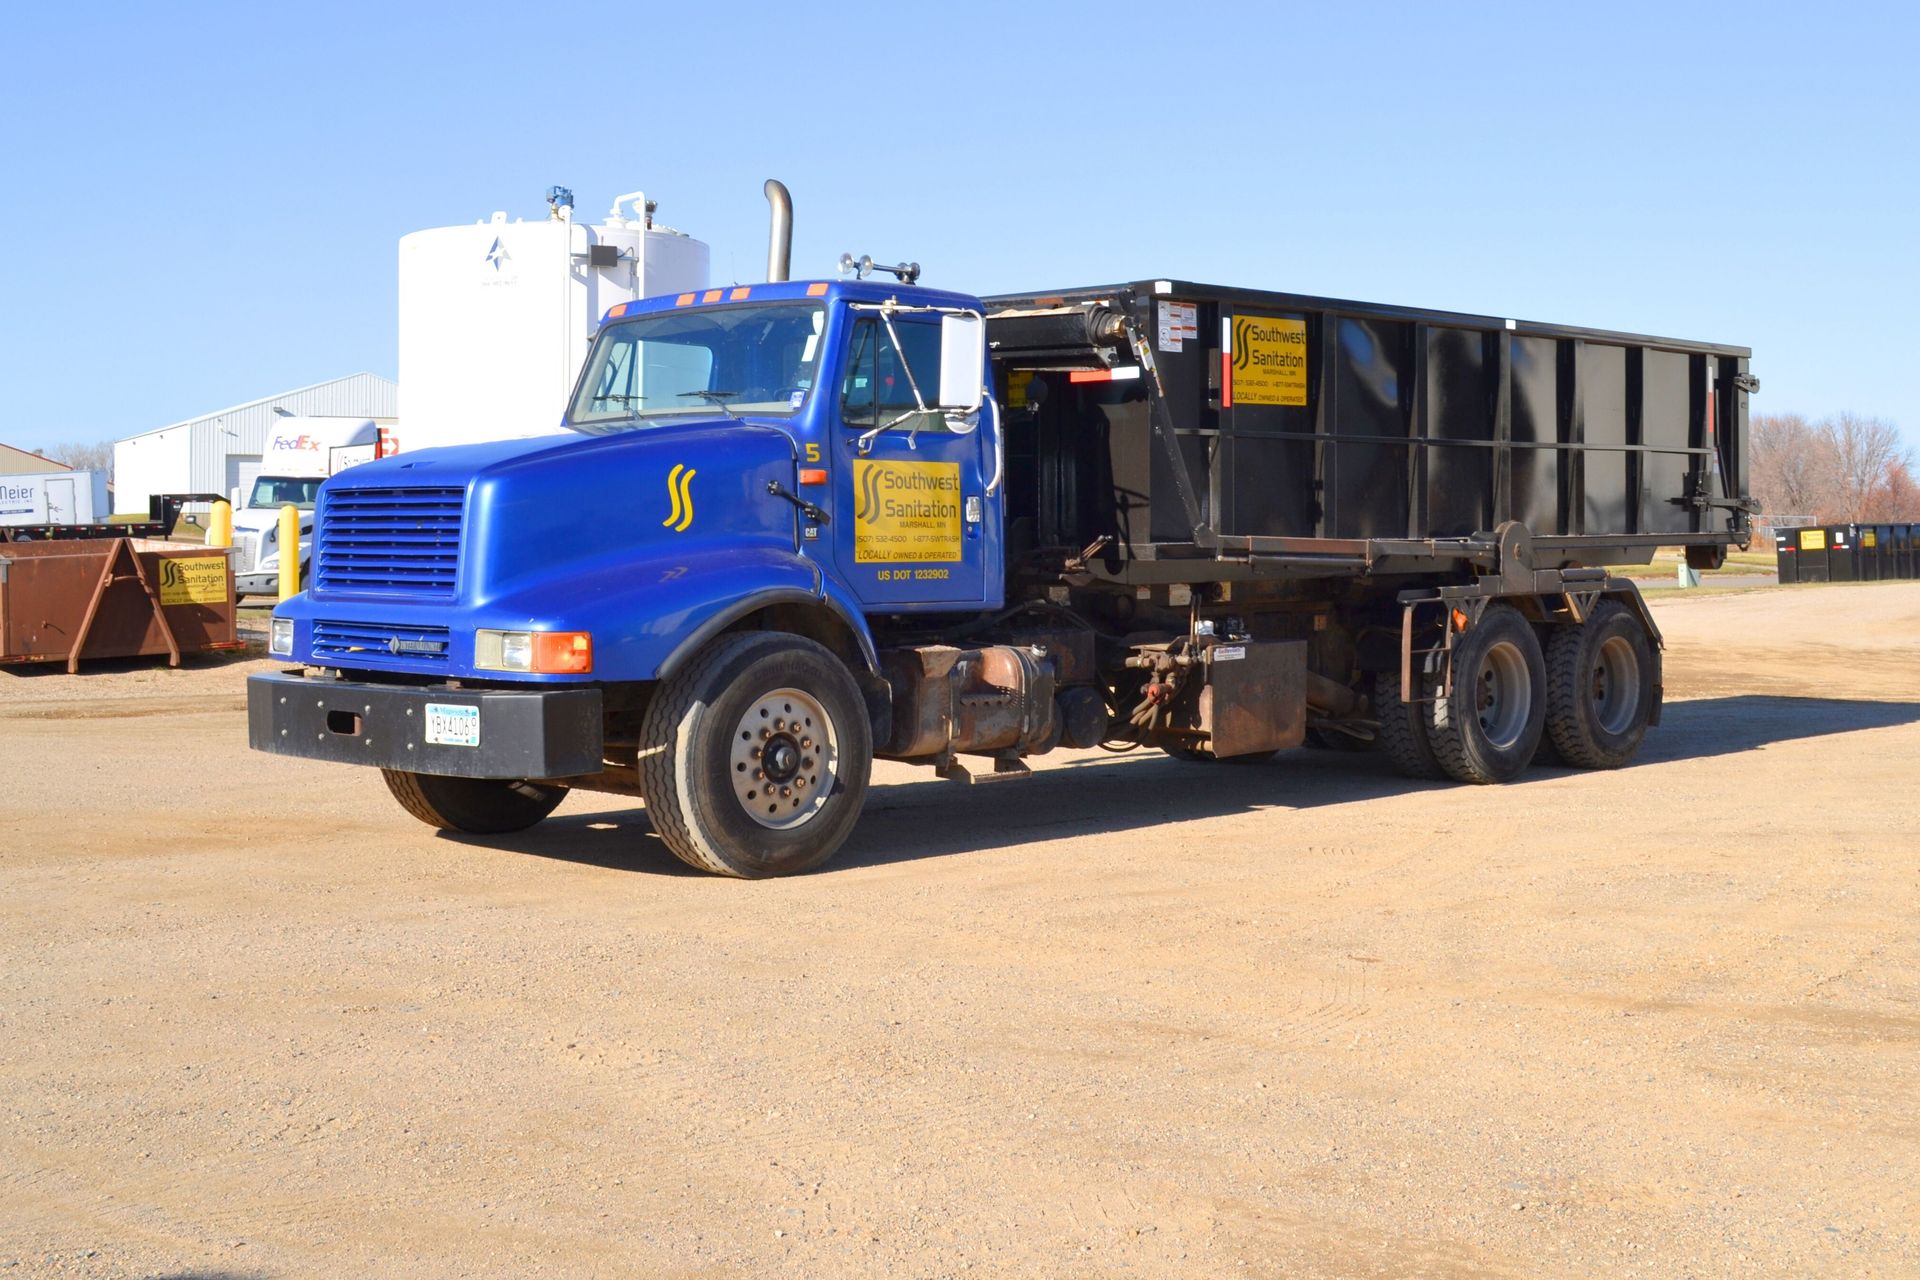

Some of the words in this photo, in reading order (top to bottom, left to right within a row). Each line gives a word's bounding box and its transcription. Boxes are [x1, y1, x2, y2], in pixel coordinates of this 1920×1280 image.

[1251, 325, 1305, 344] Southwest
[1252, 350, 1304, 368] Sanitation
[273, 435, 319, 451] FedEx
[805, 443, 820, 462] 5
[884, 470, 959, 490] Southwest
[0, 485, 34, 500] Meier
[885, 499, 957, 518] Sanitation
[805, 528, 817, 537] CAT
[893, 551, 917, 559] OWNED
[177, 562, 225, 571] Southwest
[178, 574, 224, 584] Sanitation
[877, 570, 891, 580] US
[893, 570, 911, 580] DOT
[914, 569, 949, 579] 1232902
